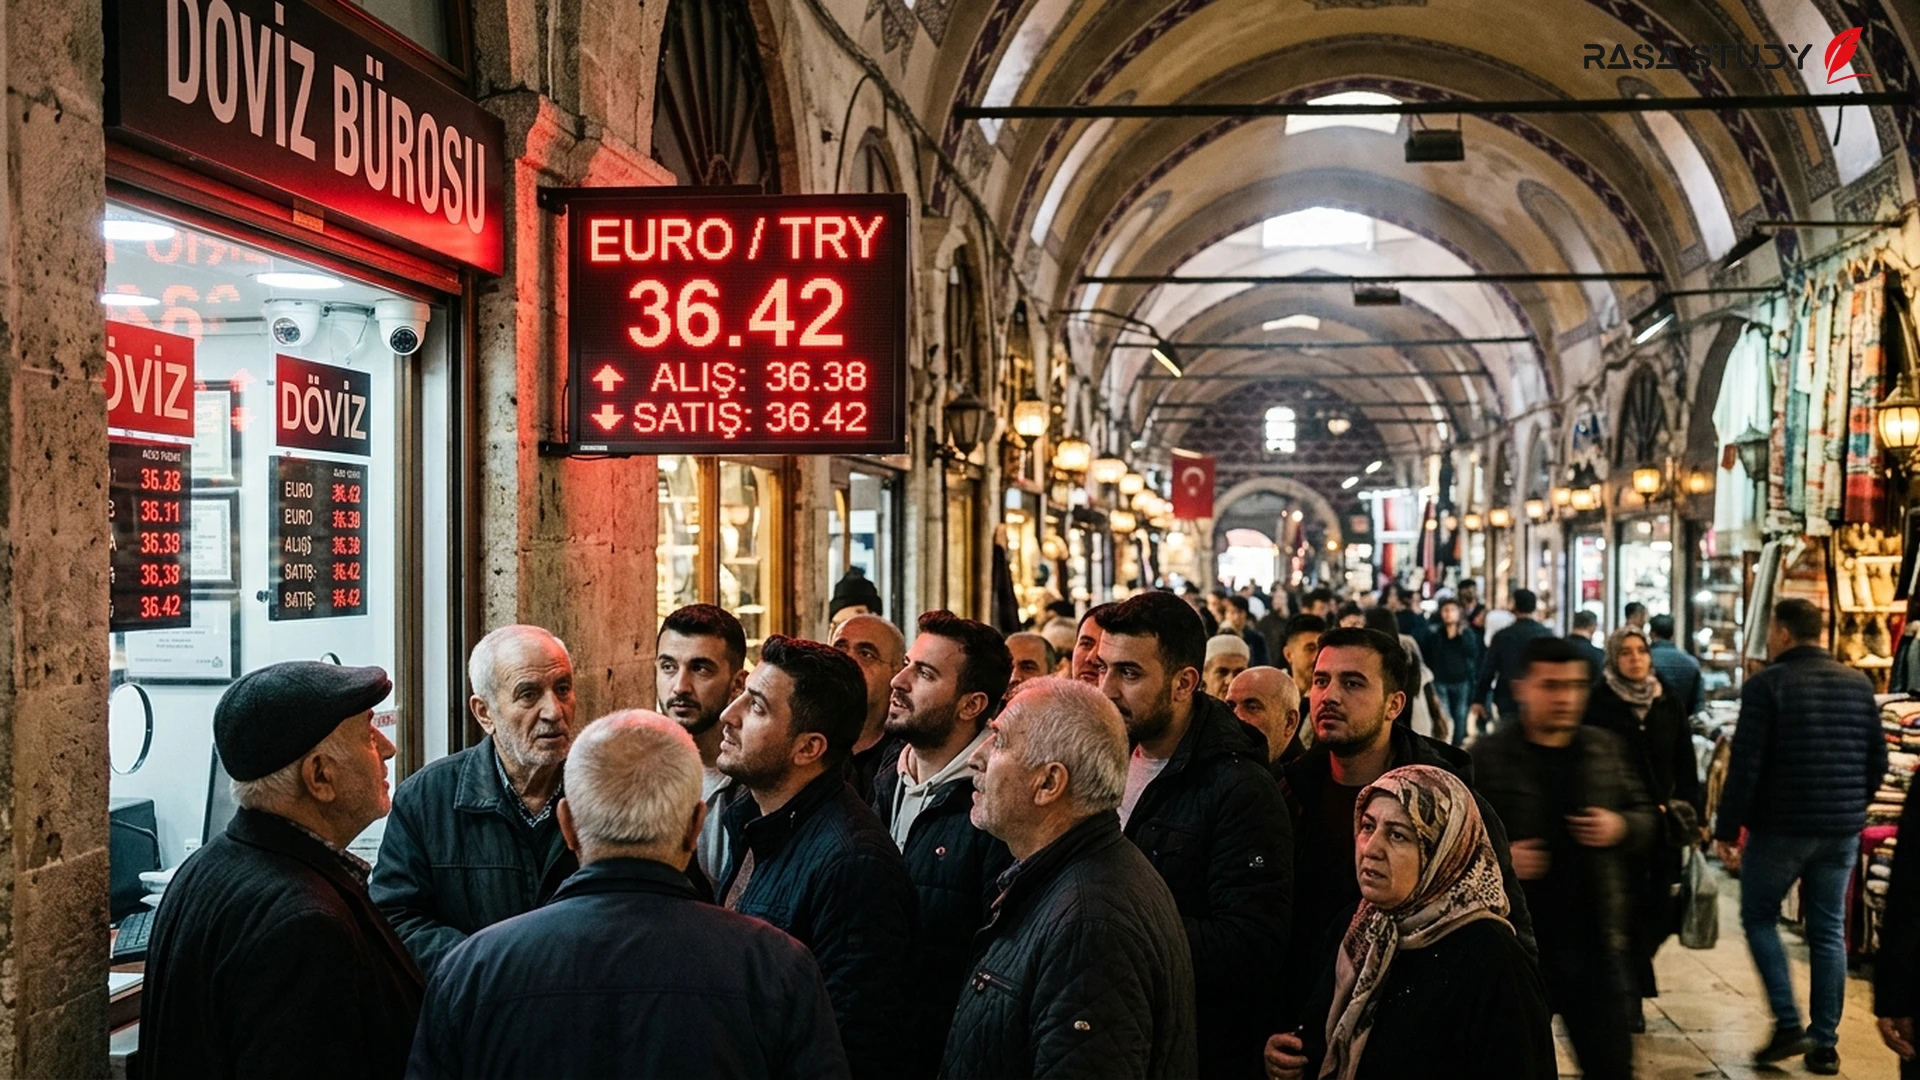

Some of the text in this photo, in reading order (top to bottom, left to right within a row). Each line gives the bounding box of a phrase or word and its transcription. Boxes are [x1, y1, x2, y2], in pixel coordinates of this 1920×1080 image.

[333, 54, 486, 235] BÜROSU
[590, 216, 884, 262] EURO / TRY
[628, 277, 843, 348] 36.42
[106, 336, 189, 420] ÖVİZ
[650, 361, 867, 399] ALIŞ: 36.38
[282, 374, 367, 440] DÖVİZ
[633, 401, 867, 439] SATIŞ: 36.42
[285, 481, 313, 499] EURO
[284, 508, 313, 526] EURO
[141, 594, 181, 618] 36.42
